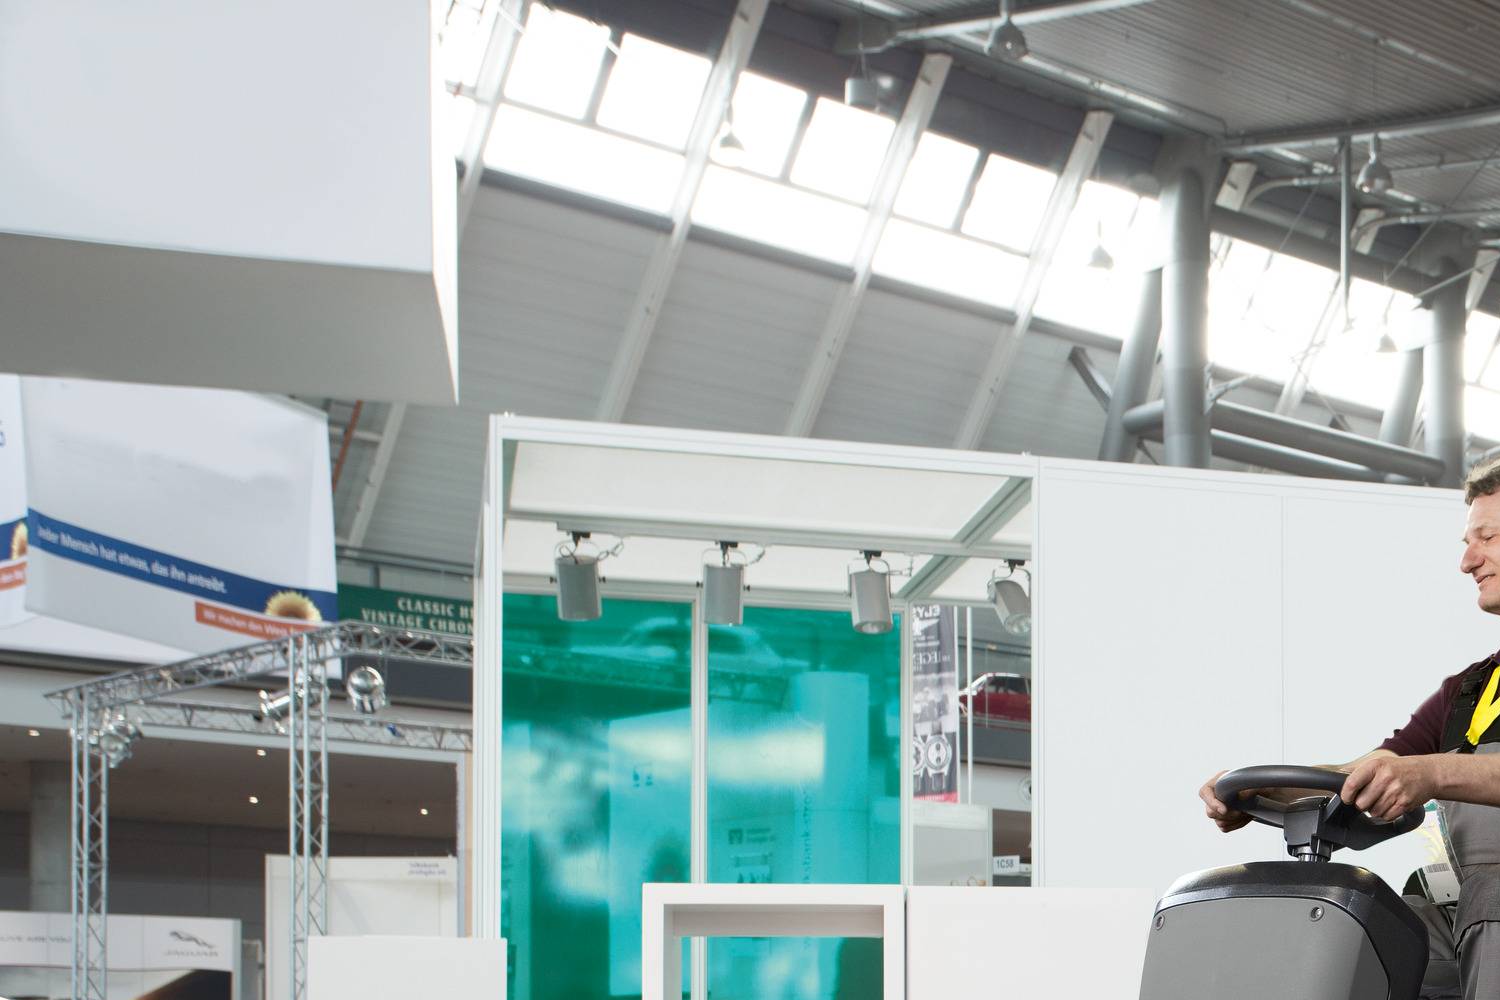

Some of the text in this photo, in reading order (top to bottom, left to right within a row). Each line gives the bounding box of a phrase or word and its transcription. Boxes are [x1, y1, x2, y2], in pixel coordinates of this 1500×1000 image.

[100, 543, 117, 563] hat
[151, 560, 169, 578] das
[397, 597, 455, 617] CLASSIC
[361, 607, 424, 628] VINTAGE
[997, 859, 1014, 868] 1C58
